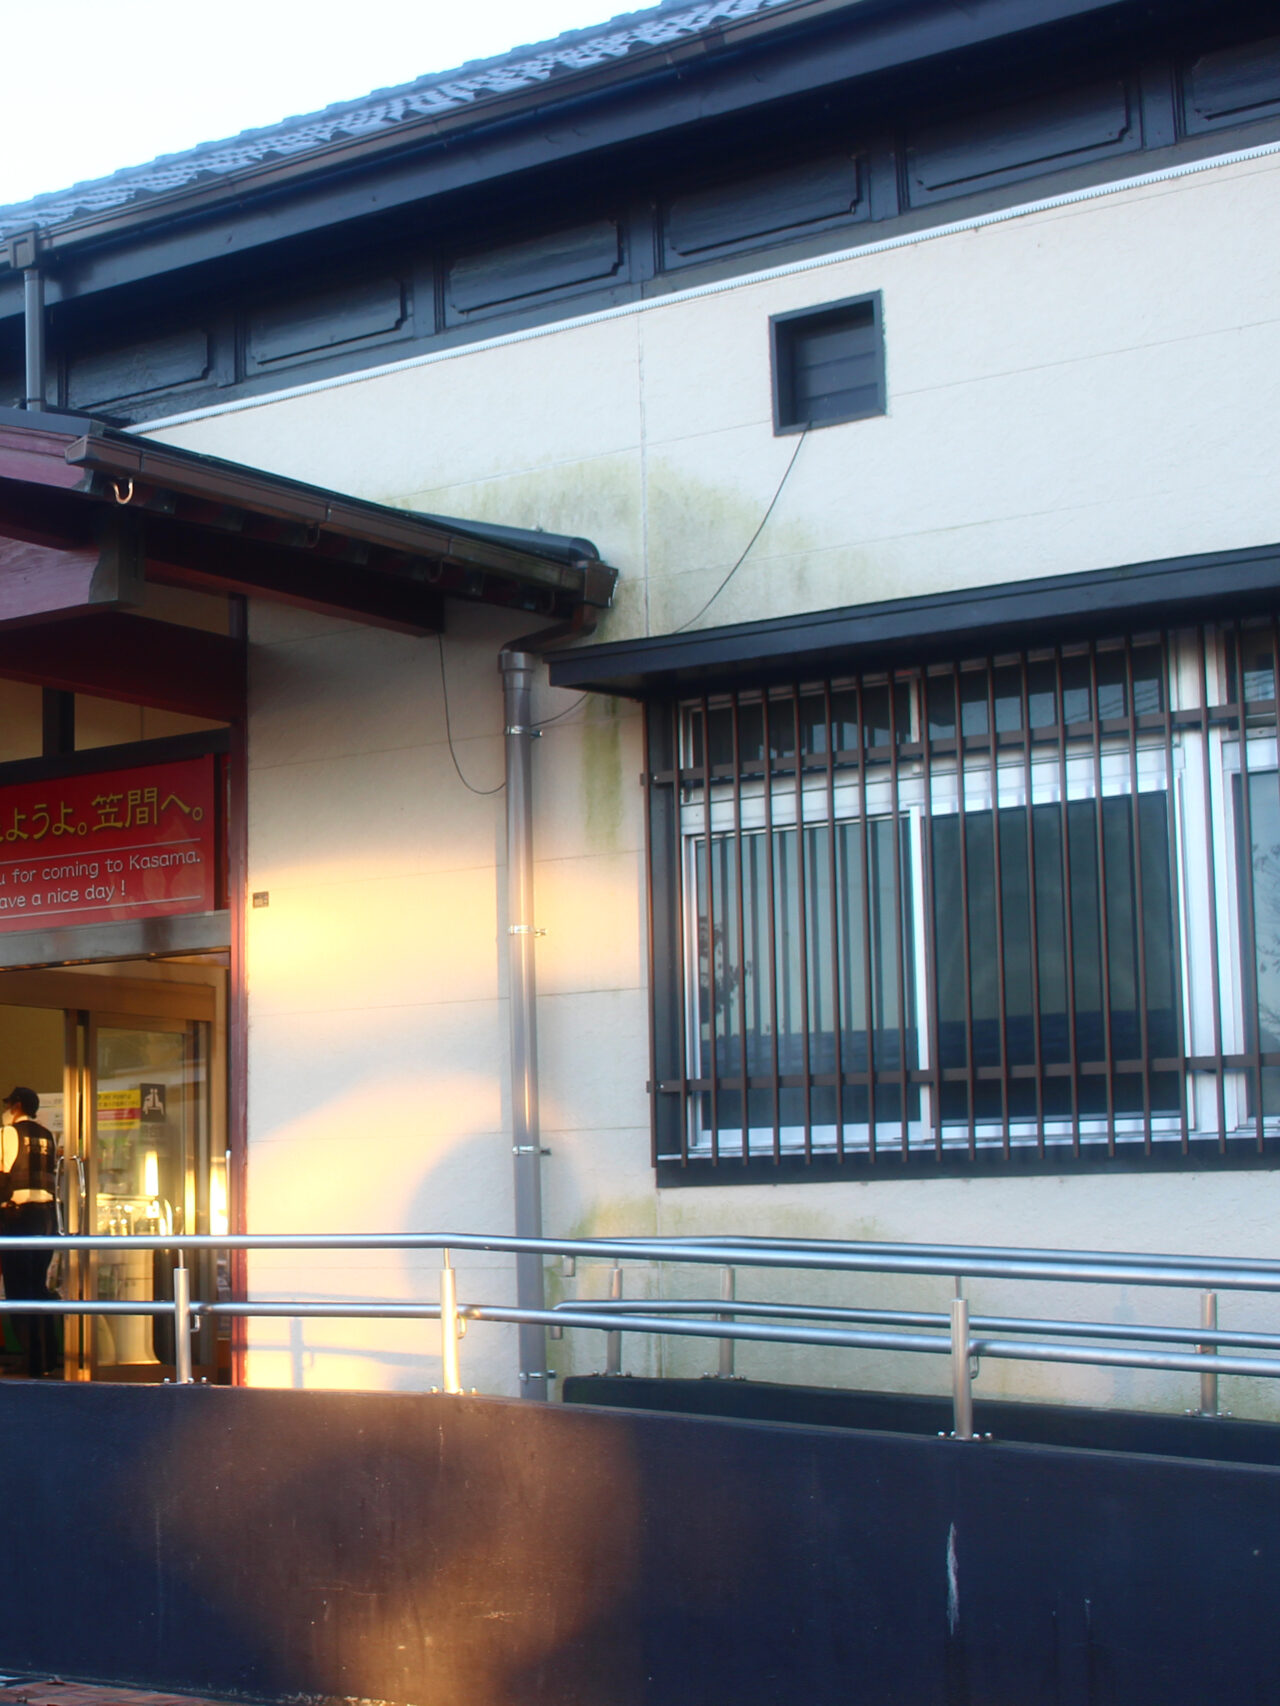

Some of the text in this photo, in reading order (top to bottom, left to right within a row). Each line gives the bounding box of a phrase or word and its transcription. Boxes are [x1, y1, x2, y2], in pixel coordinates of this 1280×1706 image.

[12, 868, 37, 884] for
[41, 861, 99, 881] coming
[105, 858, 124, 873] to
[128, 850, 201, 871] Kasama.
[31, 893, 42, 906] a
[47, 887, 80, 905] nice
[84, 884, 116, 903] day
